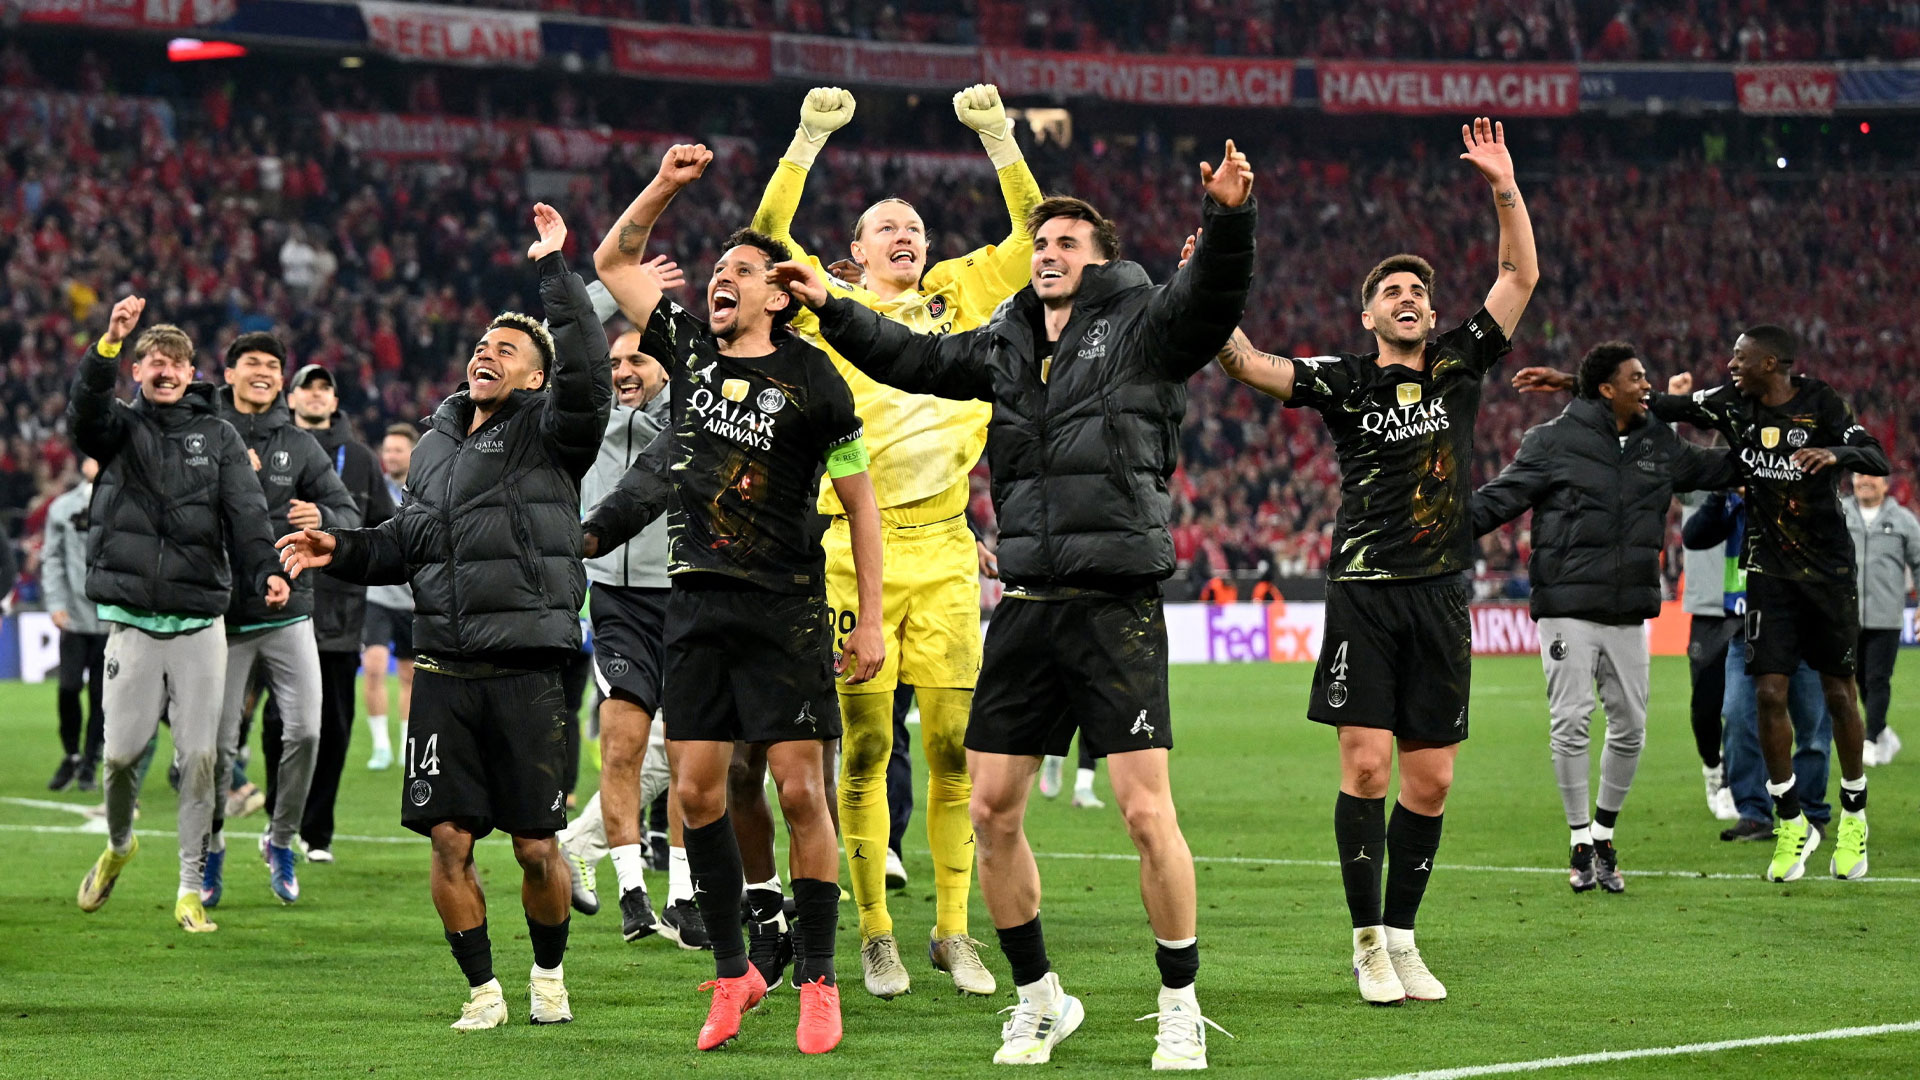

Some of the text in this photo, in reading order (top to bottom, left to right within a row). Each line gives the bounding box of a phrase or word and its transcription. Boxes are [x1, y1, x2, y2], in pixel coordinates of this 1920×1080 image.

[1322, 71, 1574, 107] HAVELMACHT
[1743, 84, 1830, 107] SAW
[691, 388, 776, 438] QATAR
[1361, 396, 1447, 435] QATAR
[1384, 416, 1450, 442] AIRWAYS
[474, 440, 504, 450] QATAR
[703, 417, 772, 451] AIRWAYS
[1753, 468, 1802, 481] AIRWAYS
[1208, 603, 1314, 662] FedEx
[1330, 640, 1349, 680] 4
[408, 733, 441, 778] 14
